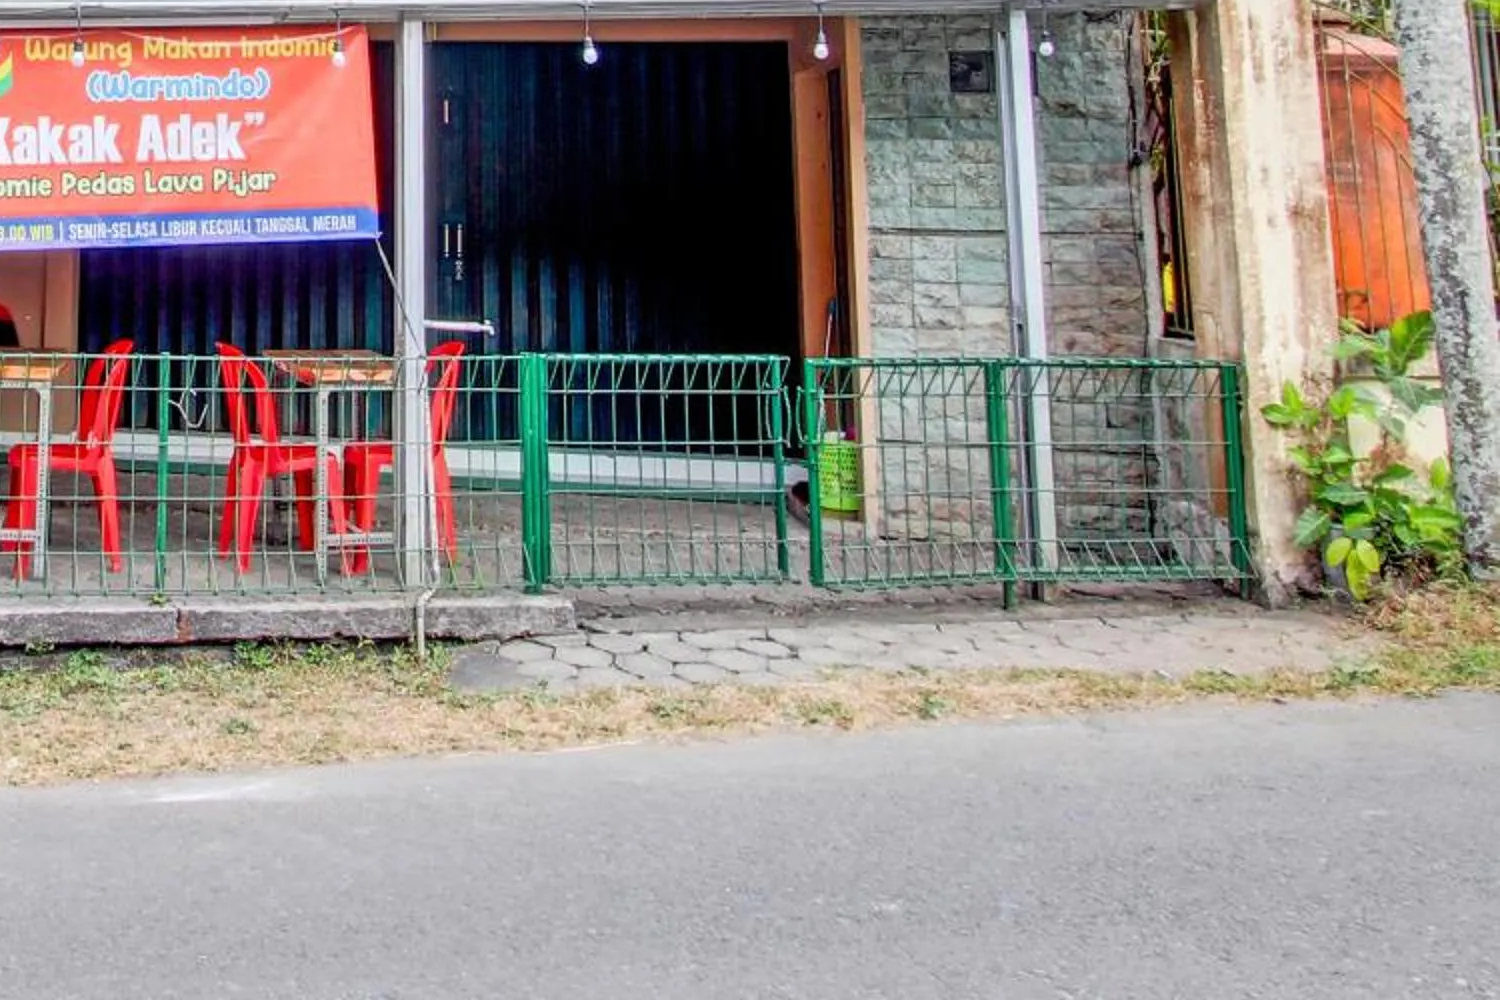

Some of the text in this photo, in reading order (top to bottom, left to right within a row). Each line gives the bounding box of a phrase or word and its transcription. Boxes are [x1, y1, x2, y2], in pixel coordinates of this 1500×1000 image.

[143, 36, 231, 61] Makan
[86, 67, 271, 102] (Warmindo)
[61, 171, 135, 197] Pedas
[144, 168, 204, 193] Lava
[212, 167, 276, 196] Pijar
[29, 224, 53, 241] WIB
[160, 218, 197, 237] LIBUR
[200, 216, 251, 235] KECUALI
[255, 215, 310, 233] TANGGAL
[313, 214, 357, 232] MERAH
